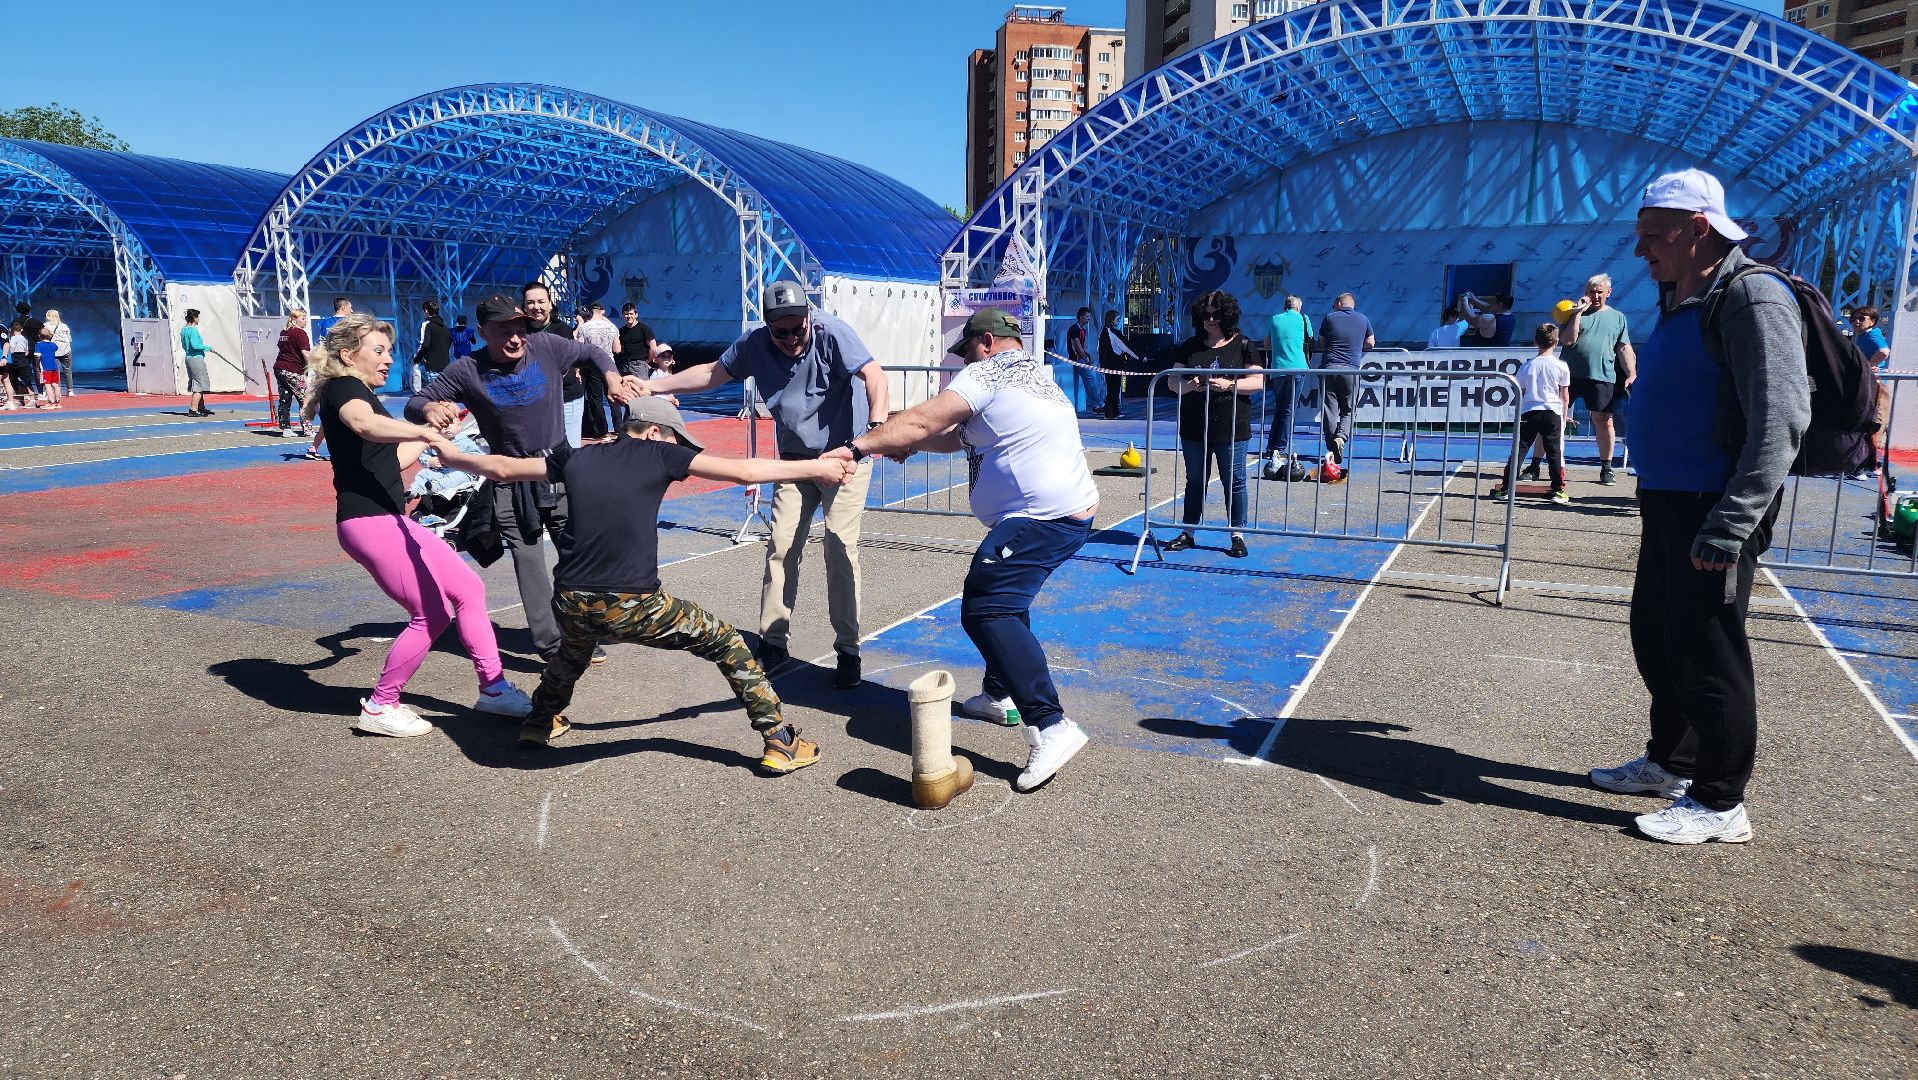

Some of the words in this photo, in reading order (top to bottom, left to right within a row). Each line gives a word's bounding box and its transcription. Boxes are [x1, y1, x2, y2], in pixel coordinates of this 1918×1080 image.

[1362, 358, 1530, 383] ОРТИВНО
[1297, 387, 1449, 409] МАНИЕ
[1461, 386, 1520, 408] НО
